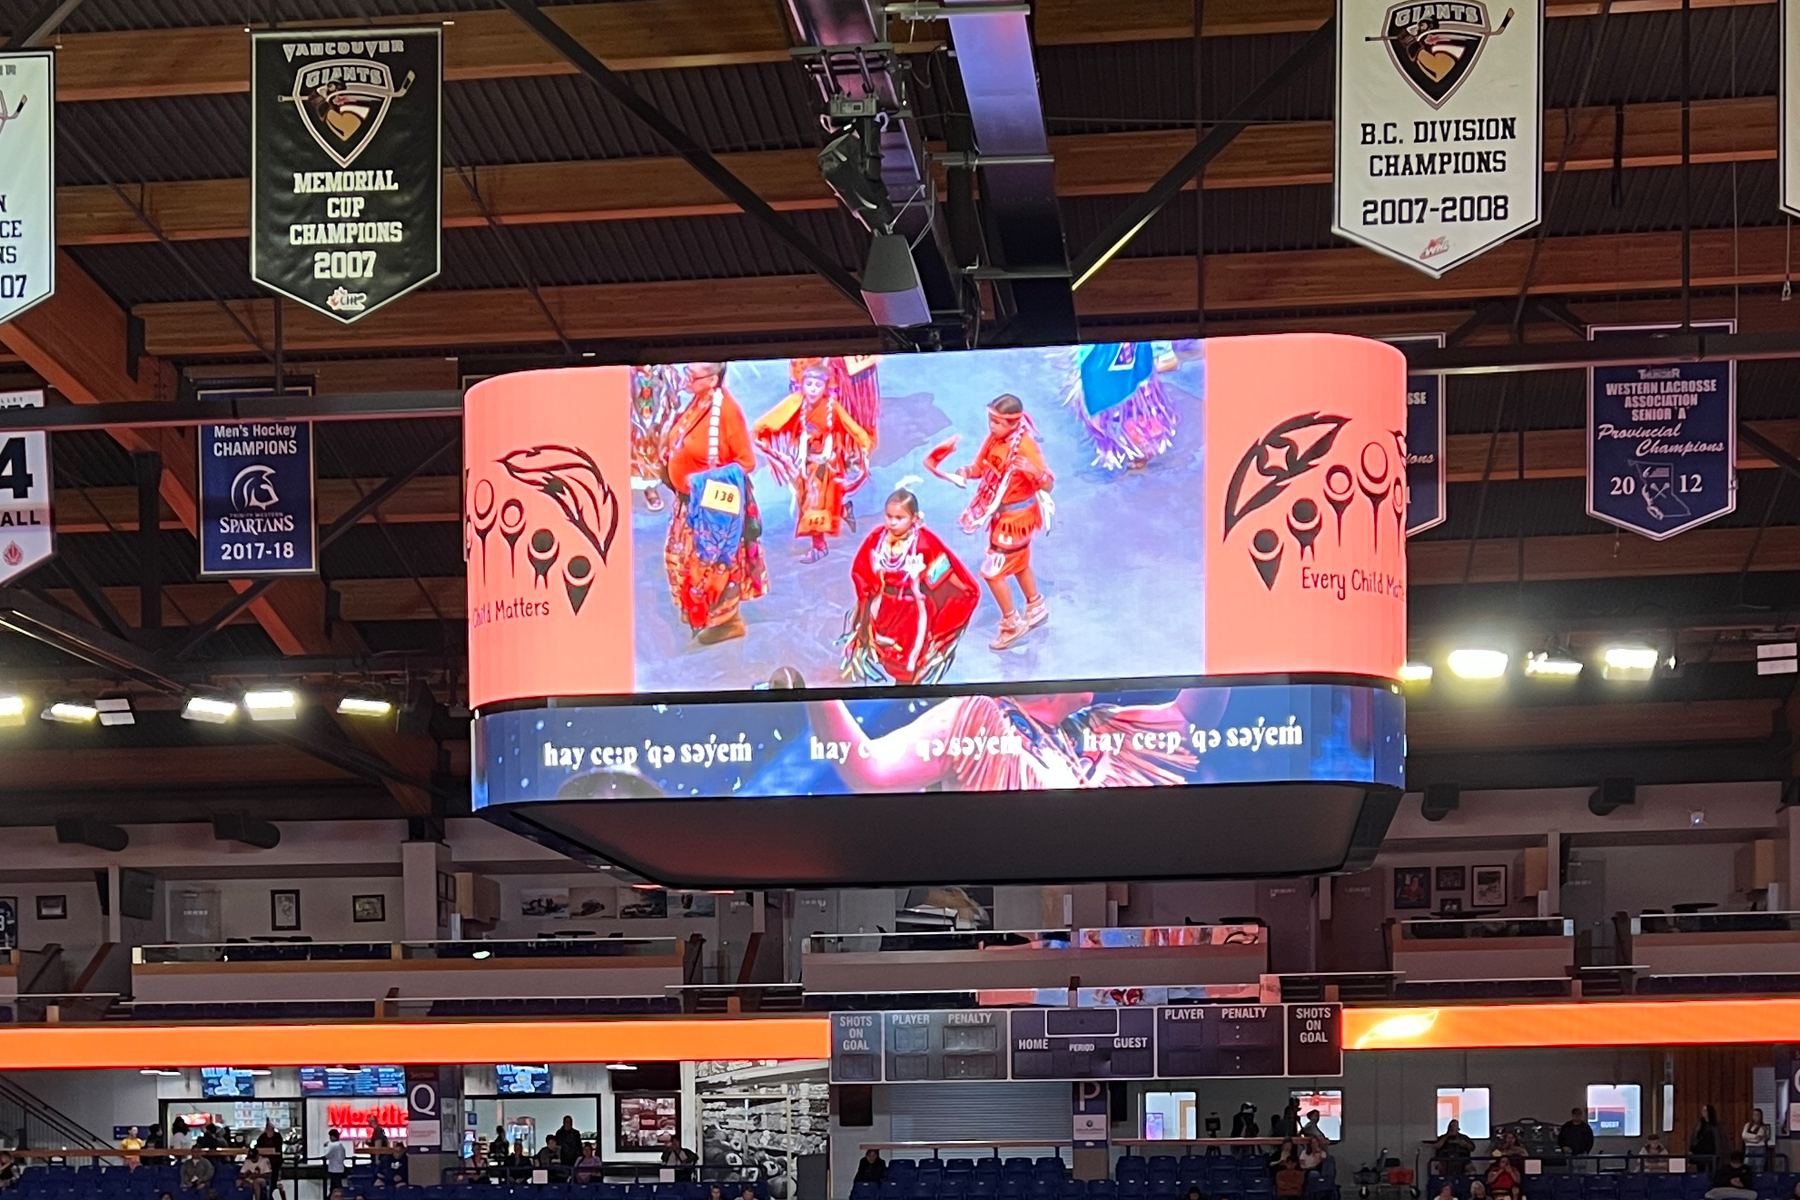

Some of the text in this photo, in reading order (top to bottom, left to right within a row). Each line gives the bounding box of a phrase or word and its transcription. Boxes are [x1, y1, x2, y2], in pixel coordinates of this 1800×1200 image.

[1395, 4, 1479, 27] GIANTS
[282, 39, 405, 62] VANCOUVER
[305, 66, 383, 88] GIANTS
[1360, 116, 1517, 145] B.C. DIVISION
[1369, 150, 1507, 177] CHAMPIONS
[293, 169, 399, 193] MEMORIAL
[326, 196, 365, 218] CUP
[1362, 194, 1509, 226] 2007-2008
[289, 221, 403, 245] CHAMPIONS
[313, 250, 377, 279] 2007
[1606, 379, 1717, 395] WESTERN LACROSSE
[1624, 394, 1698, 408] ASSOCIATION
[1631, 408, 1672, 421] SENIOR
[213, 423, 297, 438] Men's Hockey
[1597, 422, 1682, 440] Provincial
[213, 440, 298, 457] CHAMPIONS
[1635, 438, 1725, 457] Champions
[1610, 474, 1703, 495] 20 12
[714, 489, 735, 503] 138
[219, 514, 295, 536] SPARTANS
[221, 541, 295, 560] 2017-18
[1302, 566, 1346, 601] Every
[1351, 568, 1383, 595] Child
[495, 597, 550, 621] Matters
[810, 735, 852, 764] hay
[1082, 727, 1126, 756] hay
[543, 741, 585, 770] hay
[840, 1015, 873, 1027] SHOTS
[892, 1012, 993, 1025] PLAYER PENALTY
[1164, 1007, 1268, 1020] PLAYER PENALTY
[1295, 1007, 1332, 1019] SHOTS
[849, 1028, 864, 1038] ON
[1305, 1019, 1322, 1031] ON
[843, 1039, 870, 1051] GOAL
[1018, 1037, 1148, 1050] HOME GUEST
[1069, 1043, 1095, 1052] PERIOD
[1299, 1031, 1329, 1043] GOAL
[410, 1083, 436, 1116] Q
[1079, 1081, 1101, 1111] P
[327, 1103, 410, 1126] Meridia
